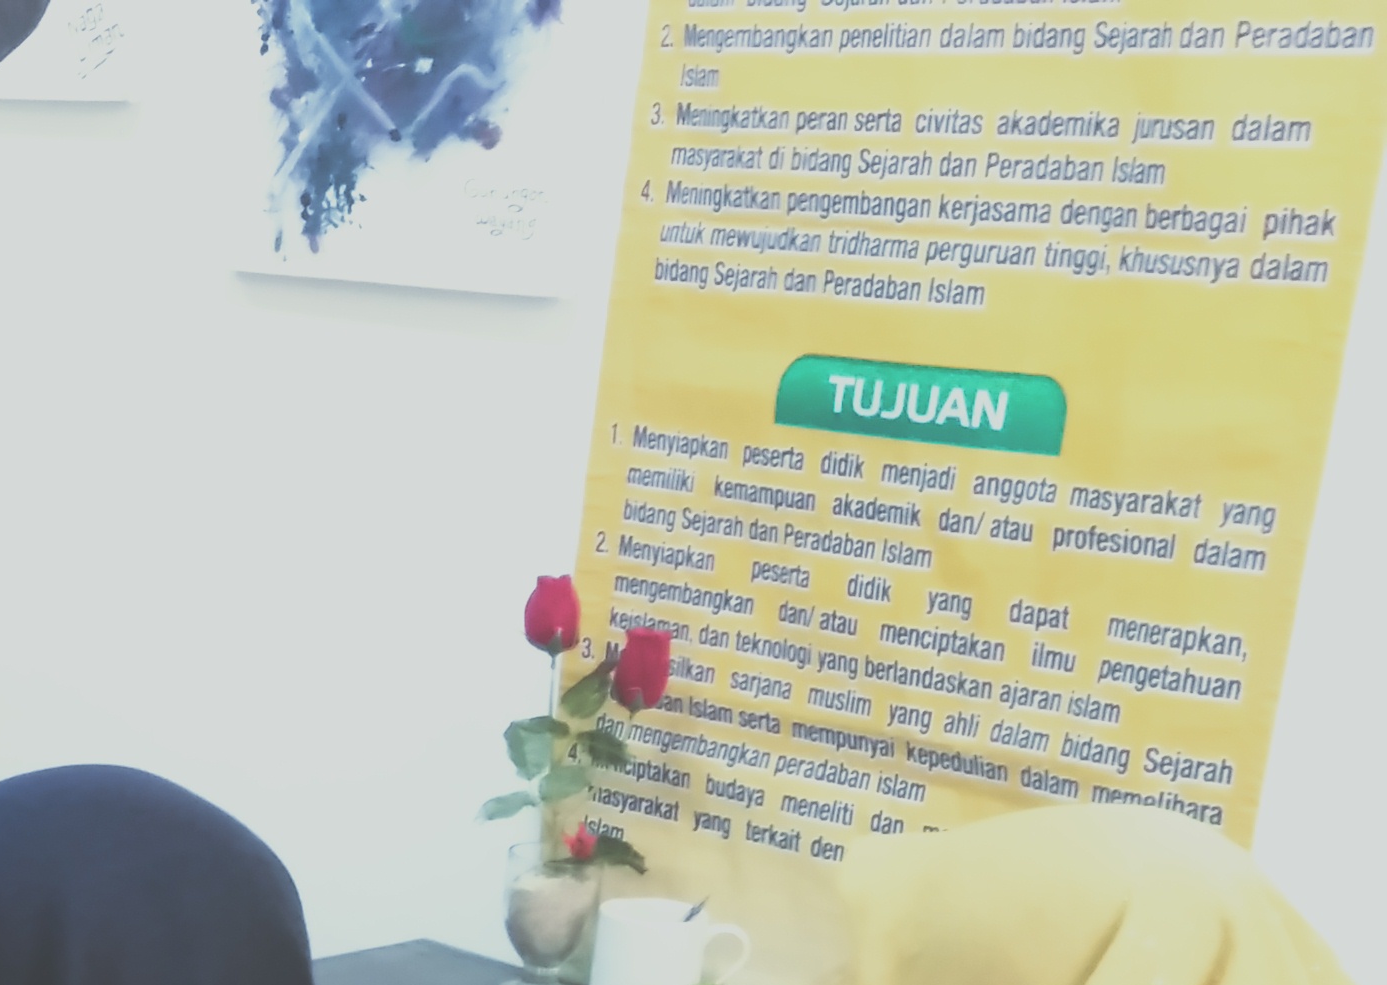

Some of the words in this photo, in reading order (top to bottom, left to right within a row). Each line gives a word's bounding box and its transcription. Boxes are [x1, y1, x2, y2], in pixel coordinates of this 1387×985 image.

[661, 24, 674, 48] 2.
[684, 23, 832, 53] Mengembangkan
[839, 22, 931, 52] penelitian
[940, 23, 1005, 49] dalam
[1012, 22, 1086, 55] bidang
[1094, 20, 1173, 54] Sejarah
[1180, 22, 1224, 48] dan
[1235, 20, 1374, 49] Peradaban
[680, 64, 720, 87] Islam
[651, 103, 665, 126] 3.
[677, 102, 789, 133] Meningkatkan
[796, 110, 847, 134] peran
[854, 109, 902, 133] serta
[916, 109, 983, 135] civitas
[997, 110, 1119, 138] akademika
[1133, 112, 1214, 144] jurusan
[1232, 113, 1311, 142] dalam
[671, 146, 763, 172] masyarakat
[769, 148, 783, 169] di
[792, 148, 851, 178] bidang
[858, 148, 931, 180] Sejarah
[940, 152, 976, 178] dan
[985, 152, 1103, 182] Peradaban
[1112, 156, 1165, 185] Islam
[641, 180, 654, 202] 4.
[666, 180, 780, 212] Meningkatkan
[787, 190, 931, 223] pengembangan
[939, 195, 1051, 226] kerjasama
[1061, 199, 1137, 232] dengan
[1146, 203, 1247, 239] berbagai
[1263, 208, 1336, 240] pihak
[655, 257, 709, 289] bidang
[714, 261, 777, 292] Sejarah
[784, 267, 816, 293] dan
[823, 269, 920, 302] Peradaban
[929, 277, 984, 306] Islam
[660, 222, 703, 245] untuk
[711, 226, 821, 254] mewujudkan
[828, 230, 918, 260] tridharma
[925, 240, 1036, 269] perguruan
[1045, 242, 1111, 276] tinggi,
[1119, 246, 1239, 284] khususnya
[1251, 253, 1328, 282] dalam
[829, 374, 1009, 431] TUJUAN
[612, 423, 622, 445] 1.
[633, 425, 728, 459] Menyiapkan
[743, 444, 803, 471] peserta
[821, 451, 865, 479] didik
[882, 462, 957, 492] menjadi
[973, 475, 1057, 505] anggota
[1069, 486, 1202, 519] masyarakat
[1219, 501, 1276, 534] yang
[624, 499, 676, 531] bidang
[682, 507, 743, 537] Sejarah
[749, 519, 778, 544] dan
[784, 523, 875, 560] Peradaban
[882, 539, 932, 568] Islam
[628, 466, 695, 493] memiliki
[714, 475, 815, 511] kemampuan
[833, 494, 921, 527] akademik
[939, 508, 985, 535] dan/
[990, 515, 1033, 542] atau
[1053, 524, 1176, 560] profesional
[1194, 539, 1266, 571] dalam
[596, 531, 608, 553] 2.
[618, 534, 715, 571] Menyiapkan
[751, 560, 810, 588] peserta
[847, 574, 891, 602] didik
[927, 590, 972, 621] yang
[1010, 599, 1069, 631] dapat
[1108, 616, 1248, 662] menerapkan,
[615, 574, 754, 615] mengembangkan
[778, 601, 814, 627] dan/
[819, 610, 858, 636] atau
[880, 622, 1005, 662] menciptakan
[1032, 642, 1076, 673] ilmu
[1098, 658, 1242, 700] pengetahuan
[699, 623, 729, 648] dan
[736, 631, 812, 669] teknologi
[818, 652, 858, 680] yang
[865, 655, 992, 699] berlandaskan
[1000, 681, 1062, 712] ajaran
[1067, 690, 1121, 723] islam
[582, 637, 595, 659] 3.
[730, 670, 792, 700] sarjana
[808, 687, 872, 716] muslim
[888, 703, 932, 734] yang
[944, 711, 981, 738] ahli
[990, 719, 1050, 751] dalam
[1061, 733, 1131, 775] bidang
[1144, 747, 1233, 785] Sejarah
[596, 713, 624, 740] dan
[627, 723, 771, 769] mengembangkan
[774, 753, 871, 792] peradaban
[877, 771, 926, 802] islam
[689, 696, 733, 724] Islam
[738, 710, 781, 735] serta
[792, 720, 895, 759] mempunyai
[906, 740, 1008, 782] kepedulian
[1020, 766, 1079, 799] dalam
[694, 810, 731, 840] yang
[746, 820, 802, 853] terkait
[706, 774, 765, 808] budaya
[781, 794, 855, 826] meneliti
[870, 810, 904, 835] dan
